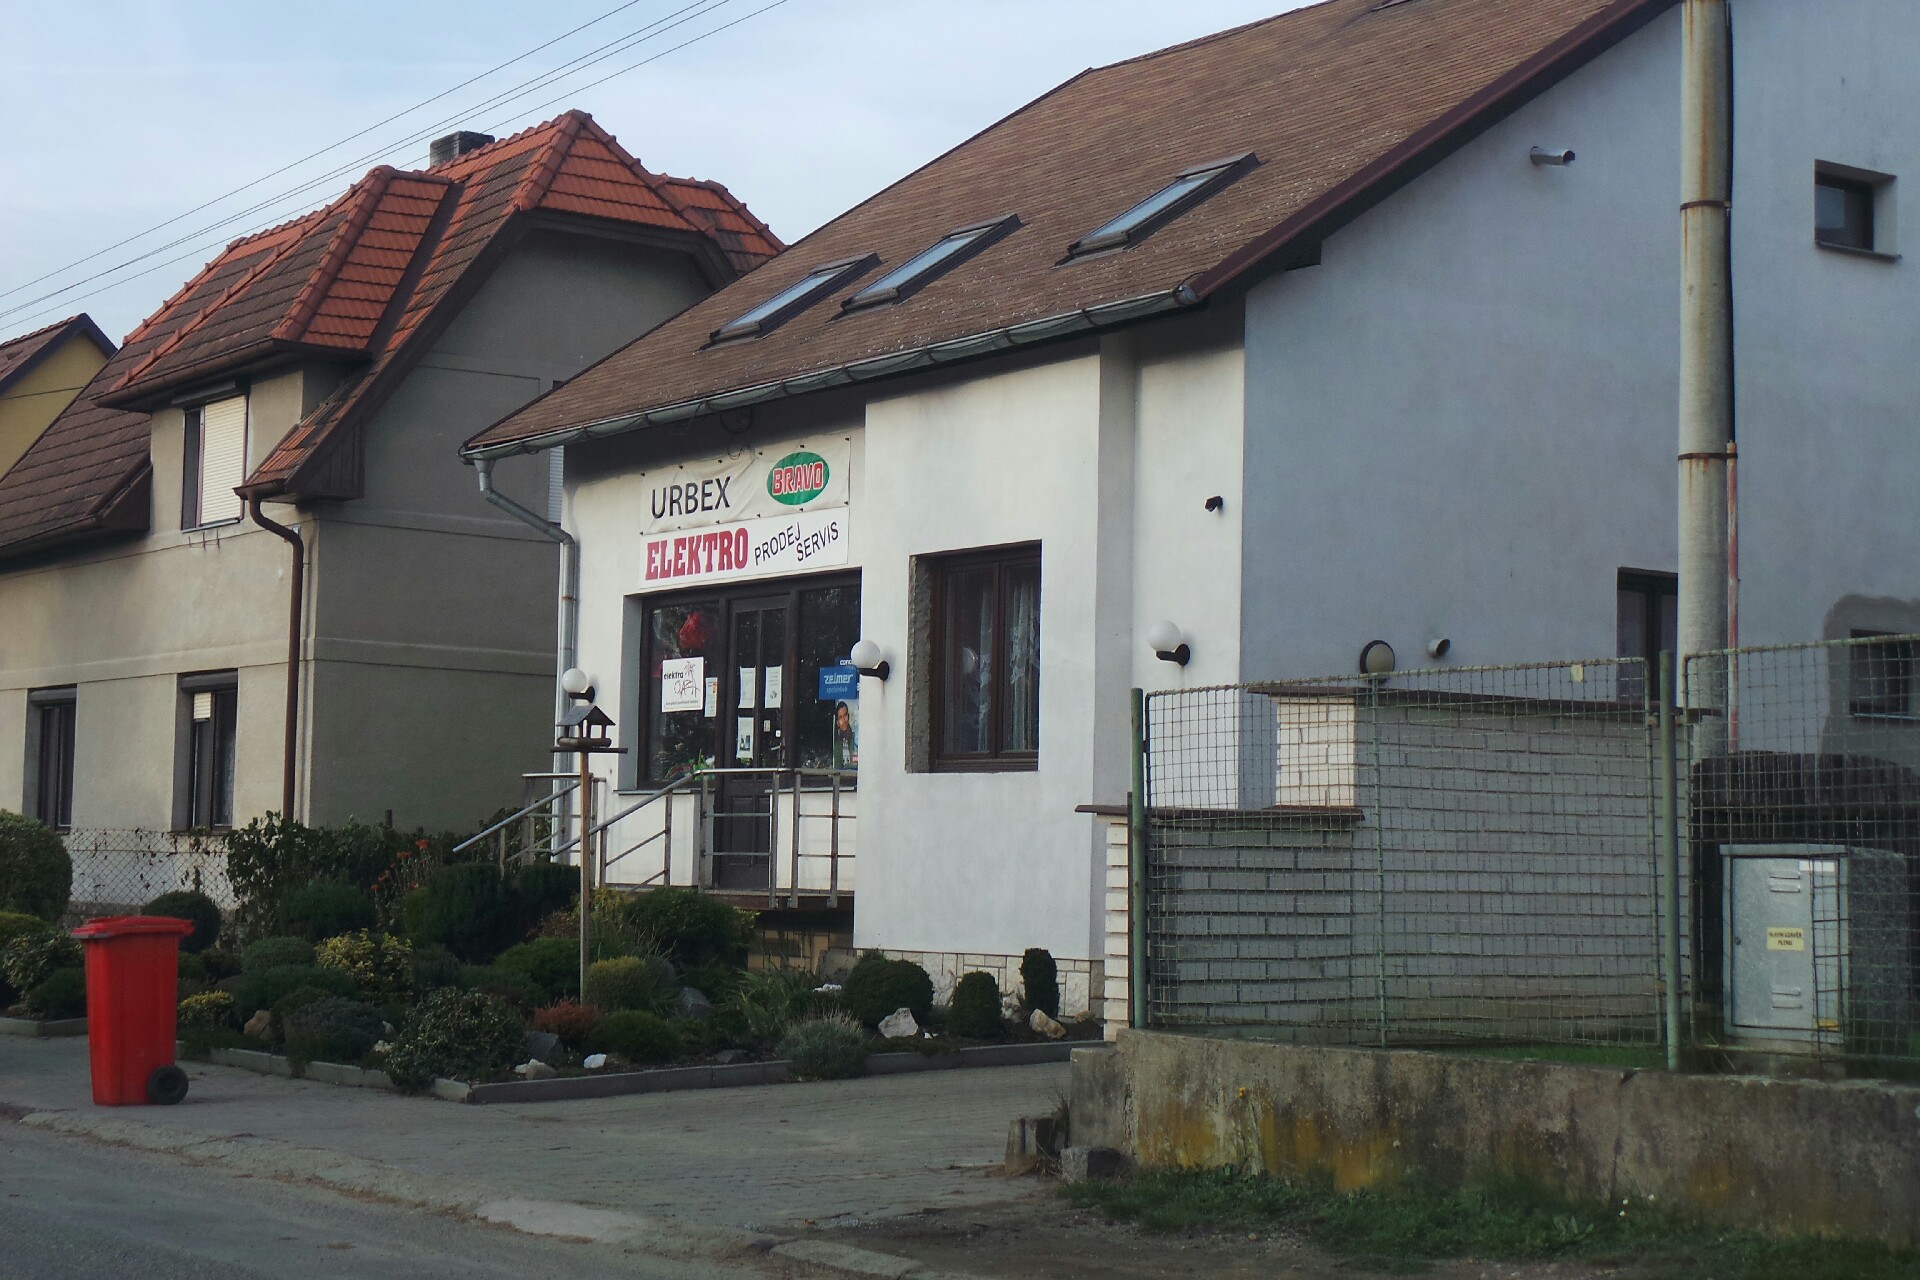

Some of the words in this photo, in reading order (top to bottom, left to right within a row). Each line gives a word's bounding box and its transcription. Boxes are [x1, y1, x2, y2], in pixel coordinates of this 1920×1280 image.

[651, 476, 731, 519] URBEX
[771, 461, 825, 496] BRAVO
[645, 527, 749, 581] ELEKTRO
[754, 521, 801, 566] PRODEJ
[797, 521, 839, 562] SERVIS
[663, 671, 684, 680] elektra
